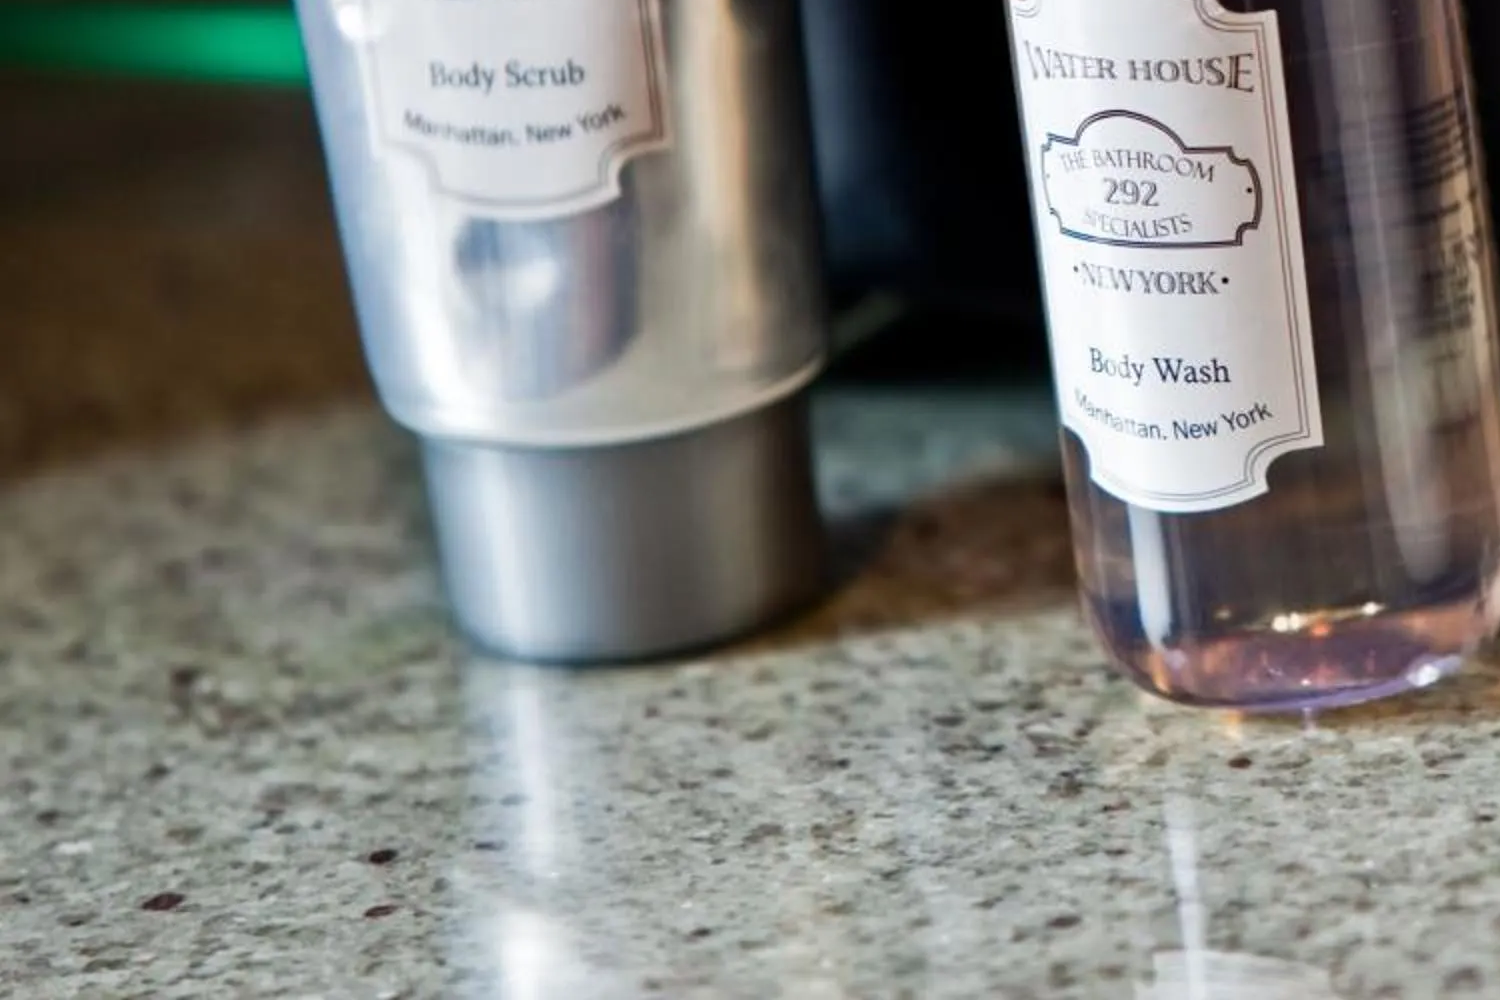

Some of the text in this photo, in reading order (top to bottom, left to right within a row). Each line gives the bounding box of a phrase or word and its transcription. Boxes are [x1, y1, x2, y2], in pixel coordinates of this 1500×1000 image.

[429, 58, 585, 96] Body Scrub
[1022, 39, 1255, 93] WATER HOUSE
[525, 124, 572, 145] New
[575, 102, 626, 133] York
[1059, 149, 1216, 183] THE BATHROOM
[1103, 177, 1161, 207] 292
[1088, 347, 1232, 386] Body Wash
[1172, 420, 1218, 440] New
[1220, 401, 1274, 434] York
